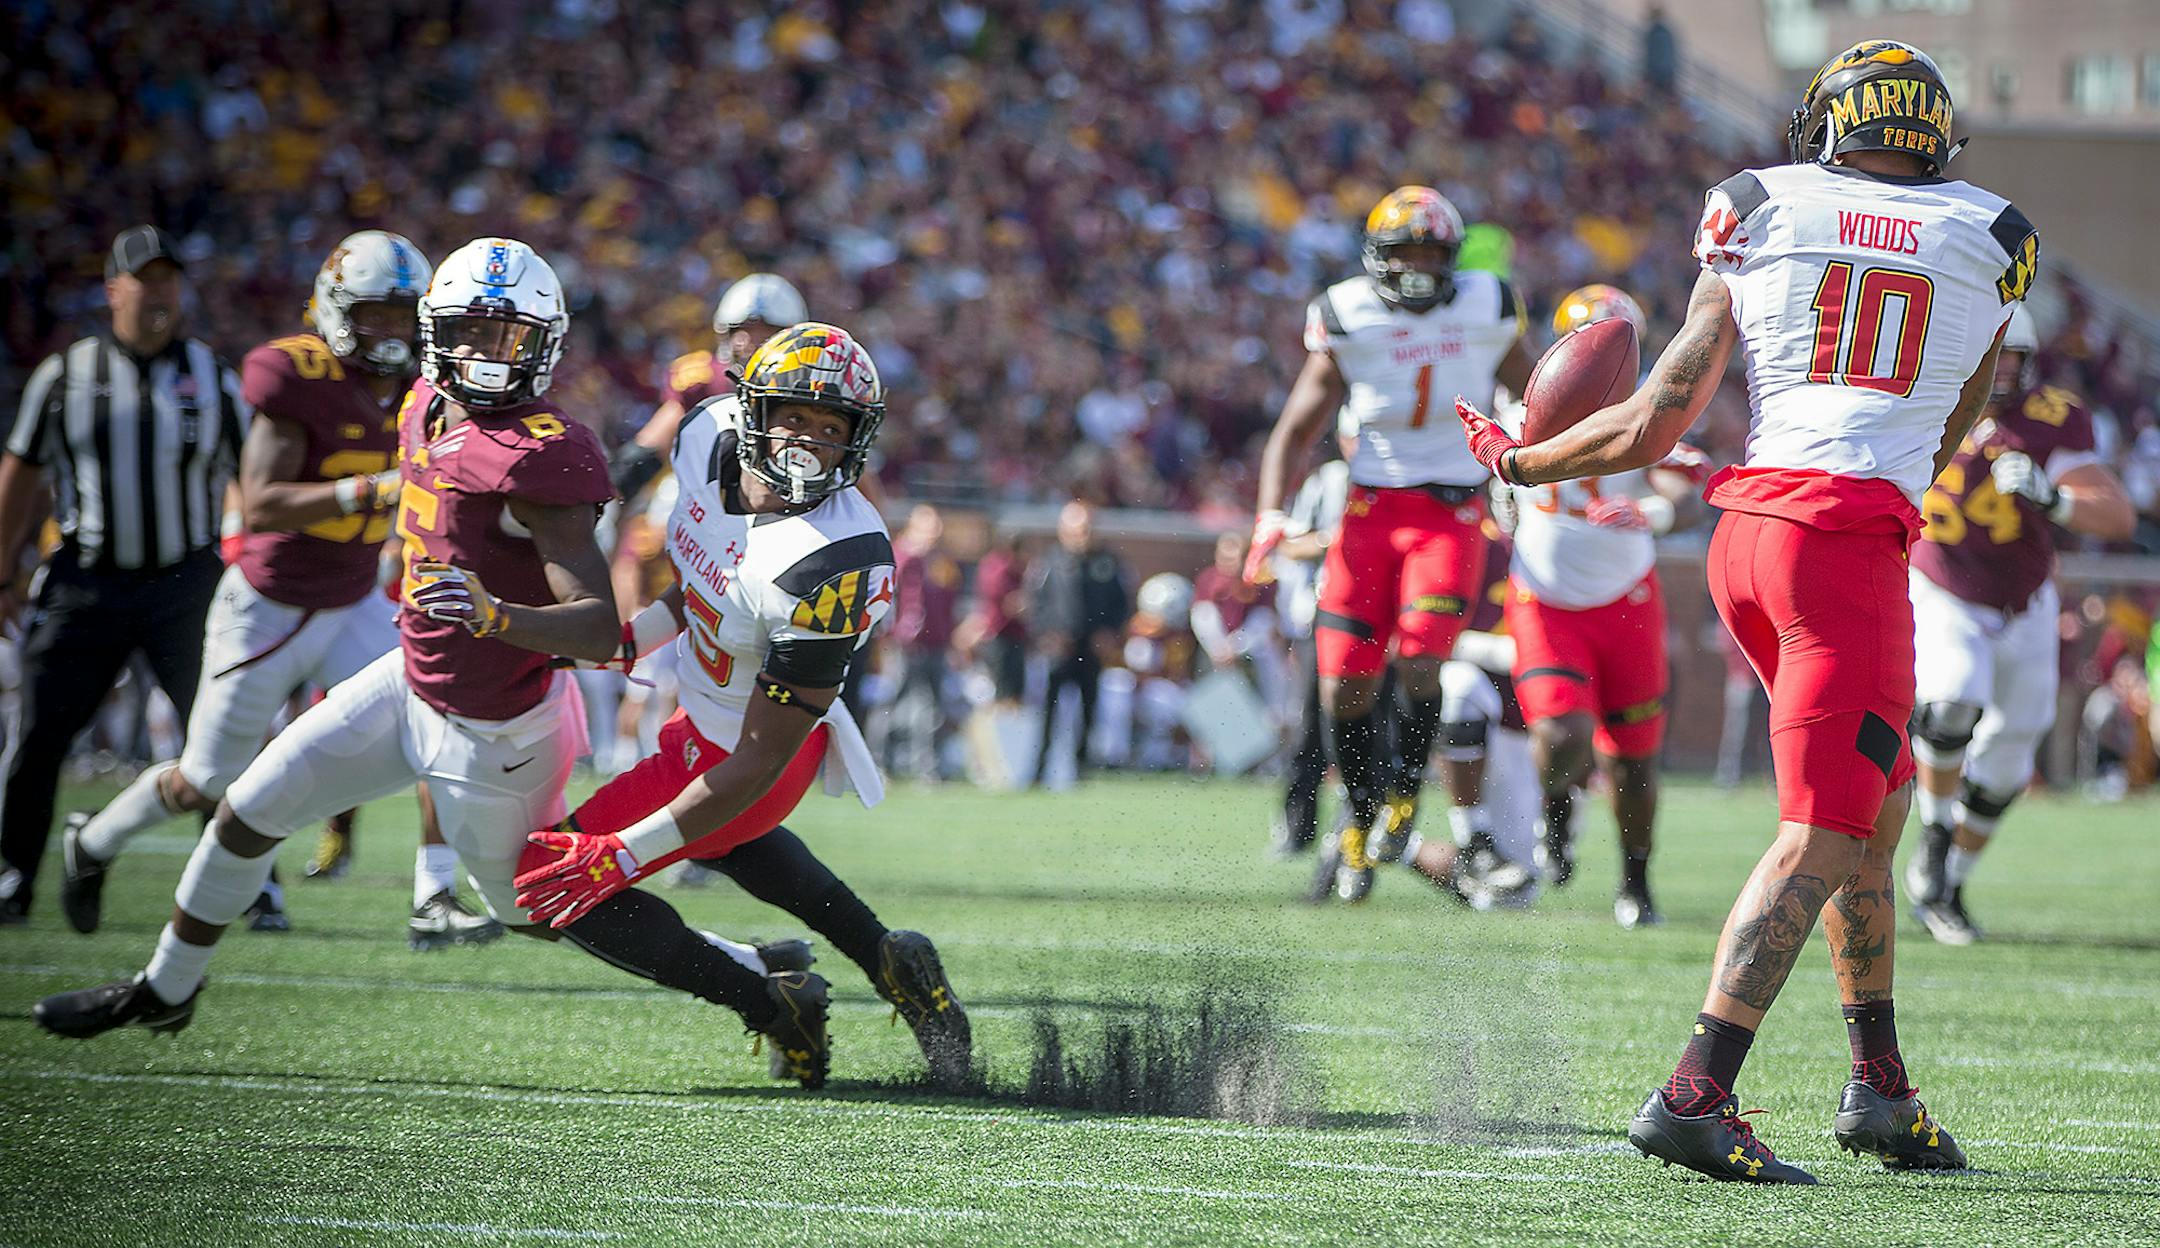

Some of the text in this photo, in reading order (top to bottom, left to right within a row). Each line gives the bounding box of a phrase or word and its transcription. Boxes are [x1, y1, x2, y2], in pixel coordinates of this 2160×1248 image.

[1882, 126, 1938, 155] TERPS
[1838, 210, 1922, 255] WOODS
[1807, 260, 1935, 399] 10
[1409, 364, 1433, 430] 1
[674, 523, 730, 597] MARYLAND
[671, 553, 735, 688] 5
